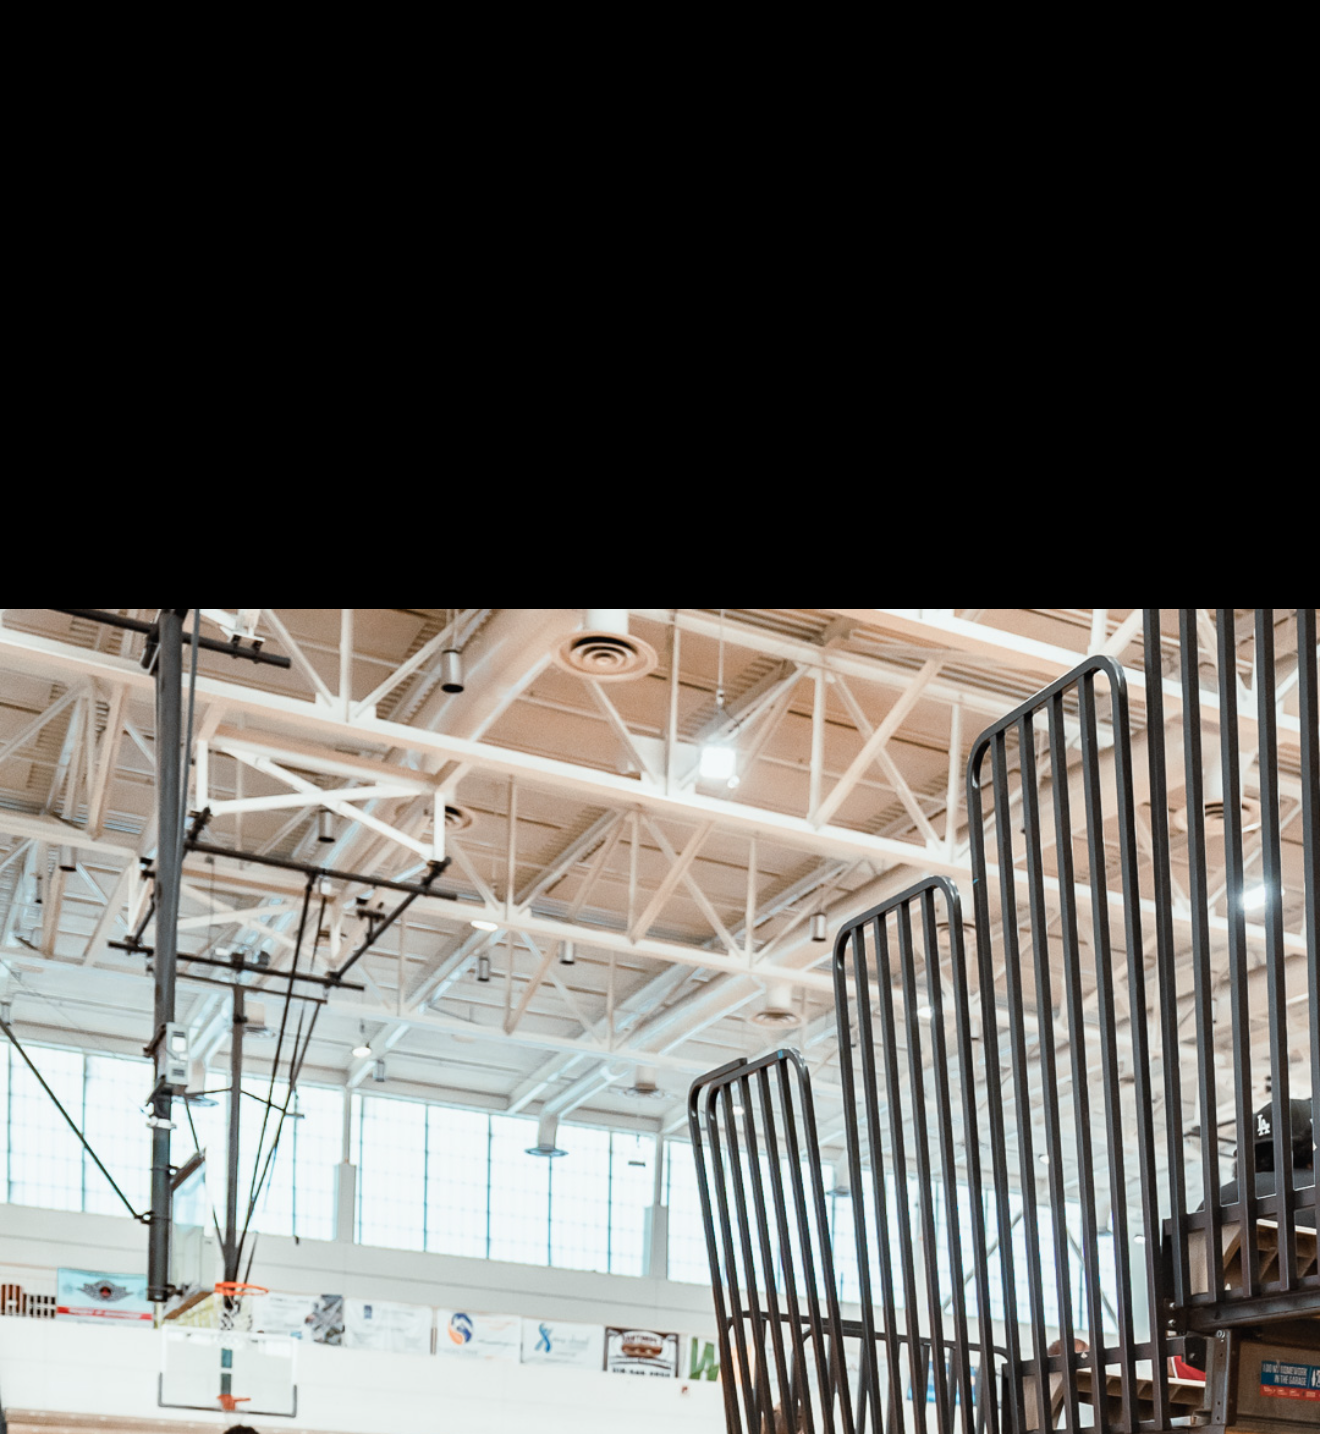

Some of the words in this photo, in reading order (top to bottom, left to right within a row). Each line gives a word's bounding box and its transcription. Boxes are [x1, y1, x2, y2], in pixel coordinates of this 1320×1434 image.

[1257, 1114, 1270, 1136] LA
[1280, 1375, 1288, 1385] THE
[1289, 1376, 1307, 1386] GARAGE
